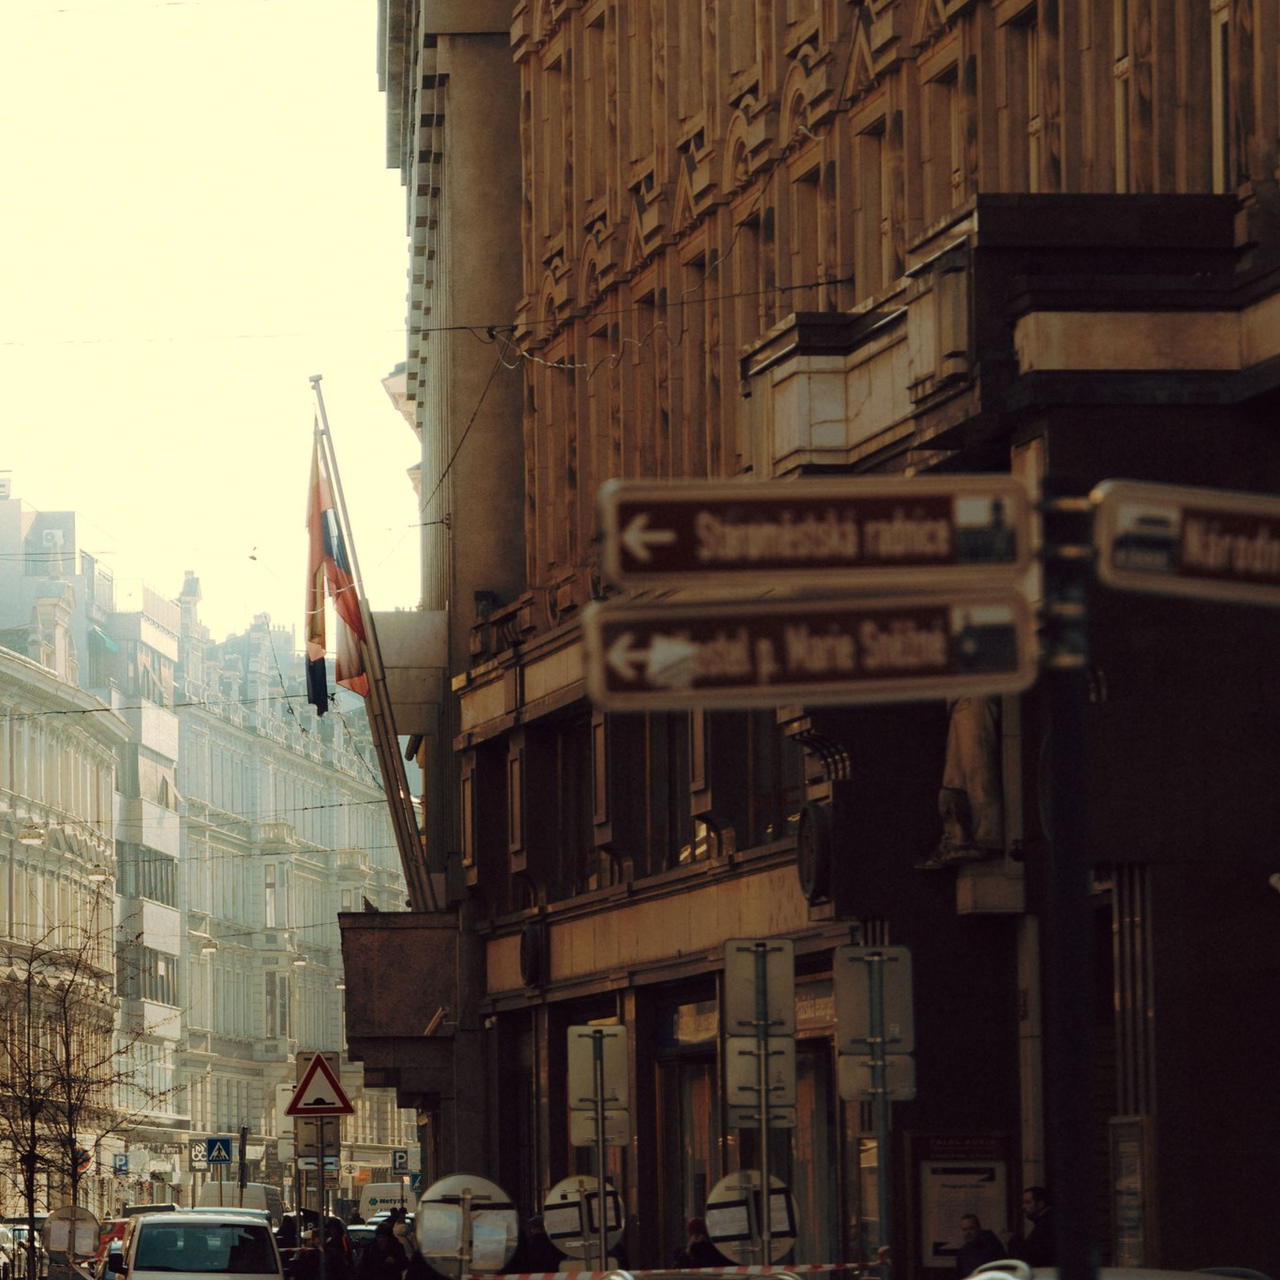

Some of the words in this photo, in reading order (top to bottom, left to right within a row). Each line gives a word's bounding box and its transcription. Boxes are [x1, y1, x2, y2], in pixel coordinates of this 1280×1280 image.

[862, 506, 950, 558] radnice
[784, 622, 856, 673] Marie
[396, 1152, 407, 1167] P
